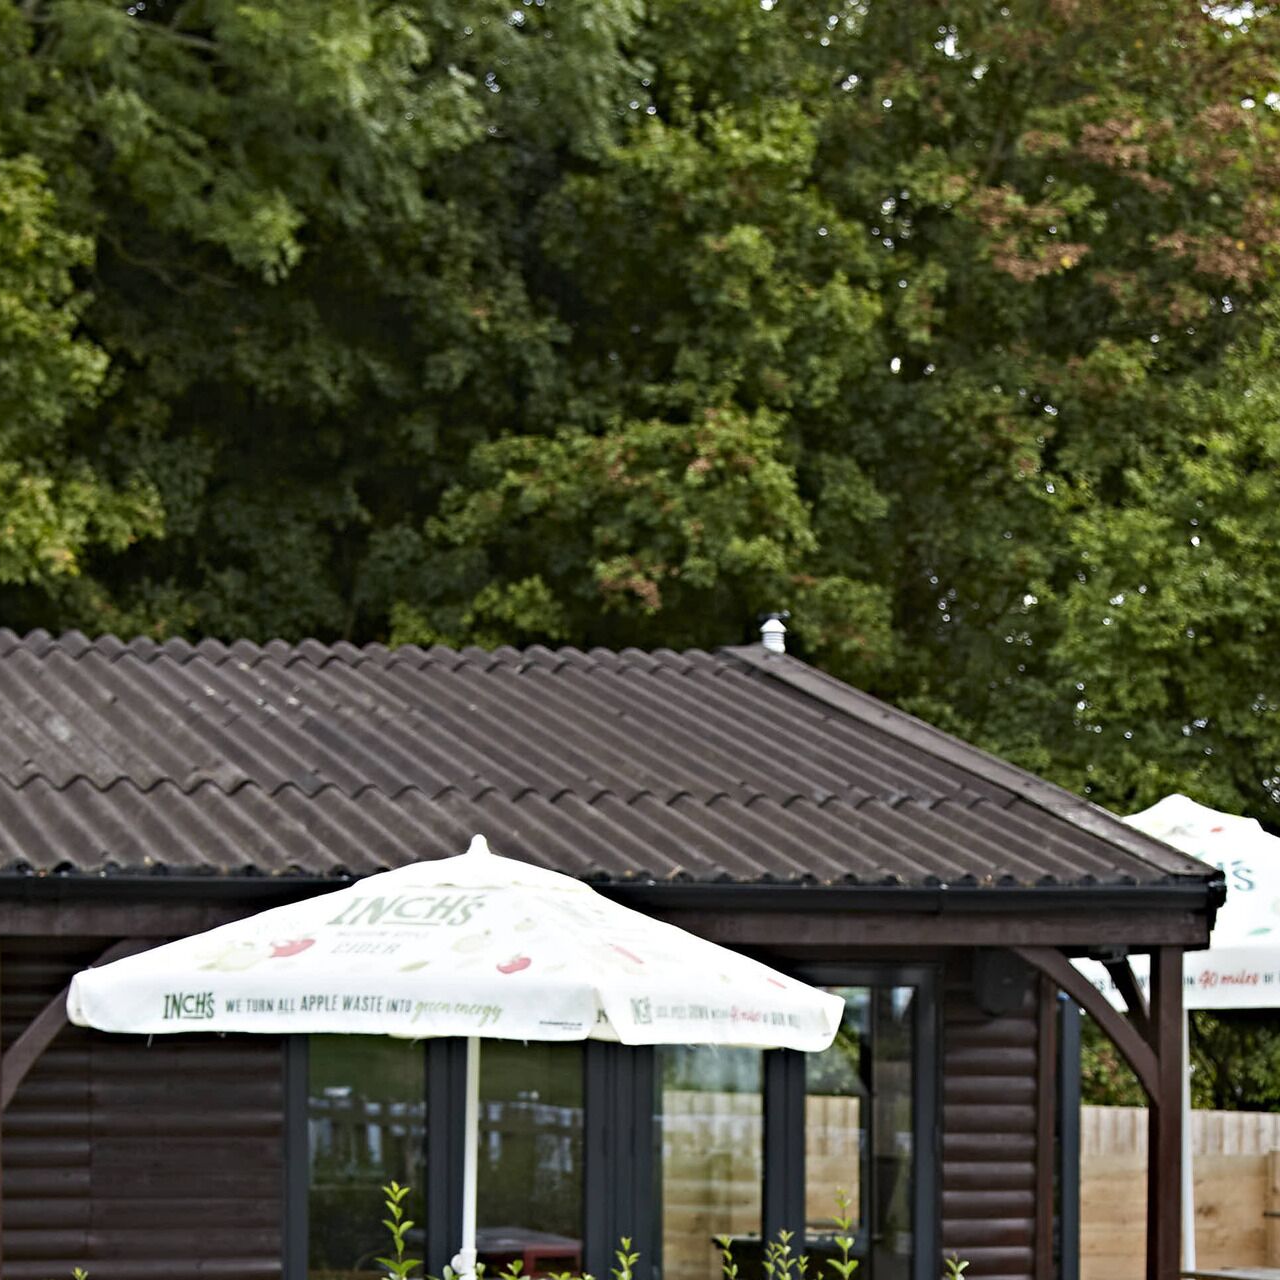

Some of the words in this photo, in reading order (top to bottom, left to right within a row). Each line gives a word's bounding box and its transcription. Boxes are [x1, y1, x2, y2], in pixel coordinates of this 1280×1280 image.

[326, 894, 488, 926] INCH'S
[163, 992, 215, 1020] INCH'S
[225, 999, 241, 1013] WE
[246, 999, 273, 1013] TURN
[277, 998, 296, 1013] ALL
[300, 994, 338, 1012] APPLE
[342, 995, 383, 1013] WASTE
[386, 998, 412, 1013] INTO
[453, 1000, 504, 1028] energy
